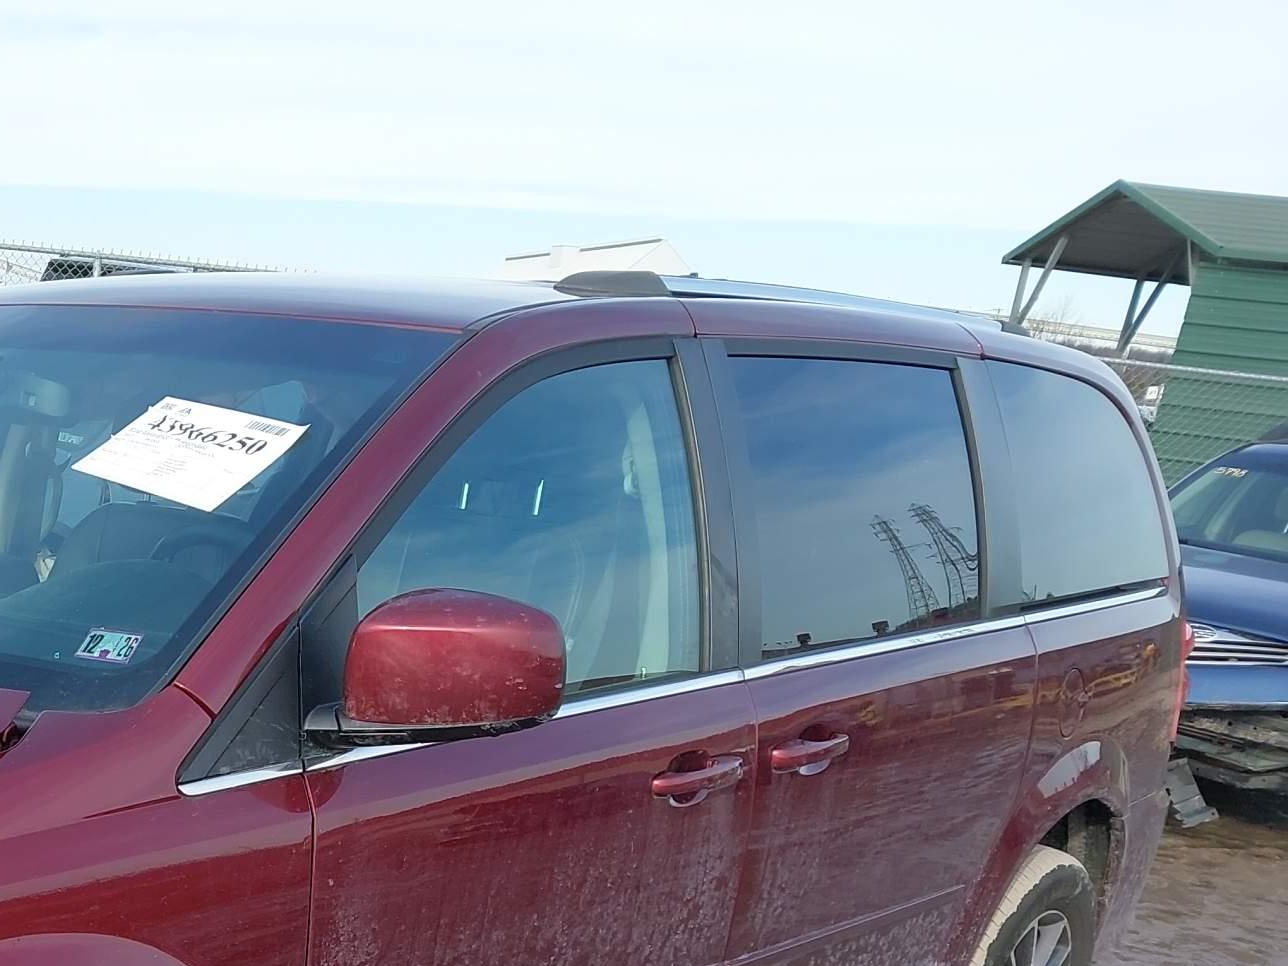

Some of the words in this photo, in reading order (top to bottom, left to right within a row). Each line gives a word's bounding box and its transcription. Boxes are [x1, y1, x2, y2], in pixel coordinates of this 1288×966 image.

[147, 415, 268, 455] 43966250
[82, 633, 105, 654] 12
[116, 636, 139, 657] 26
